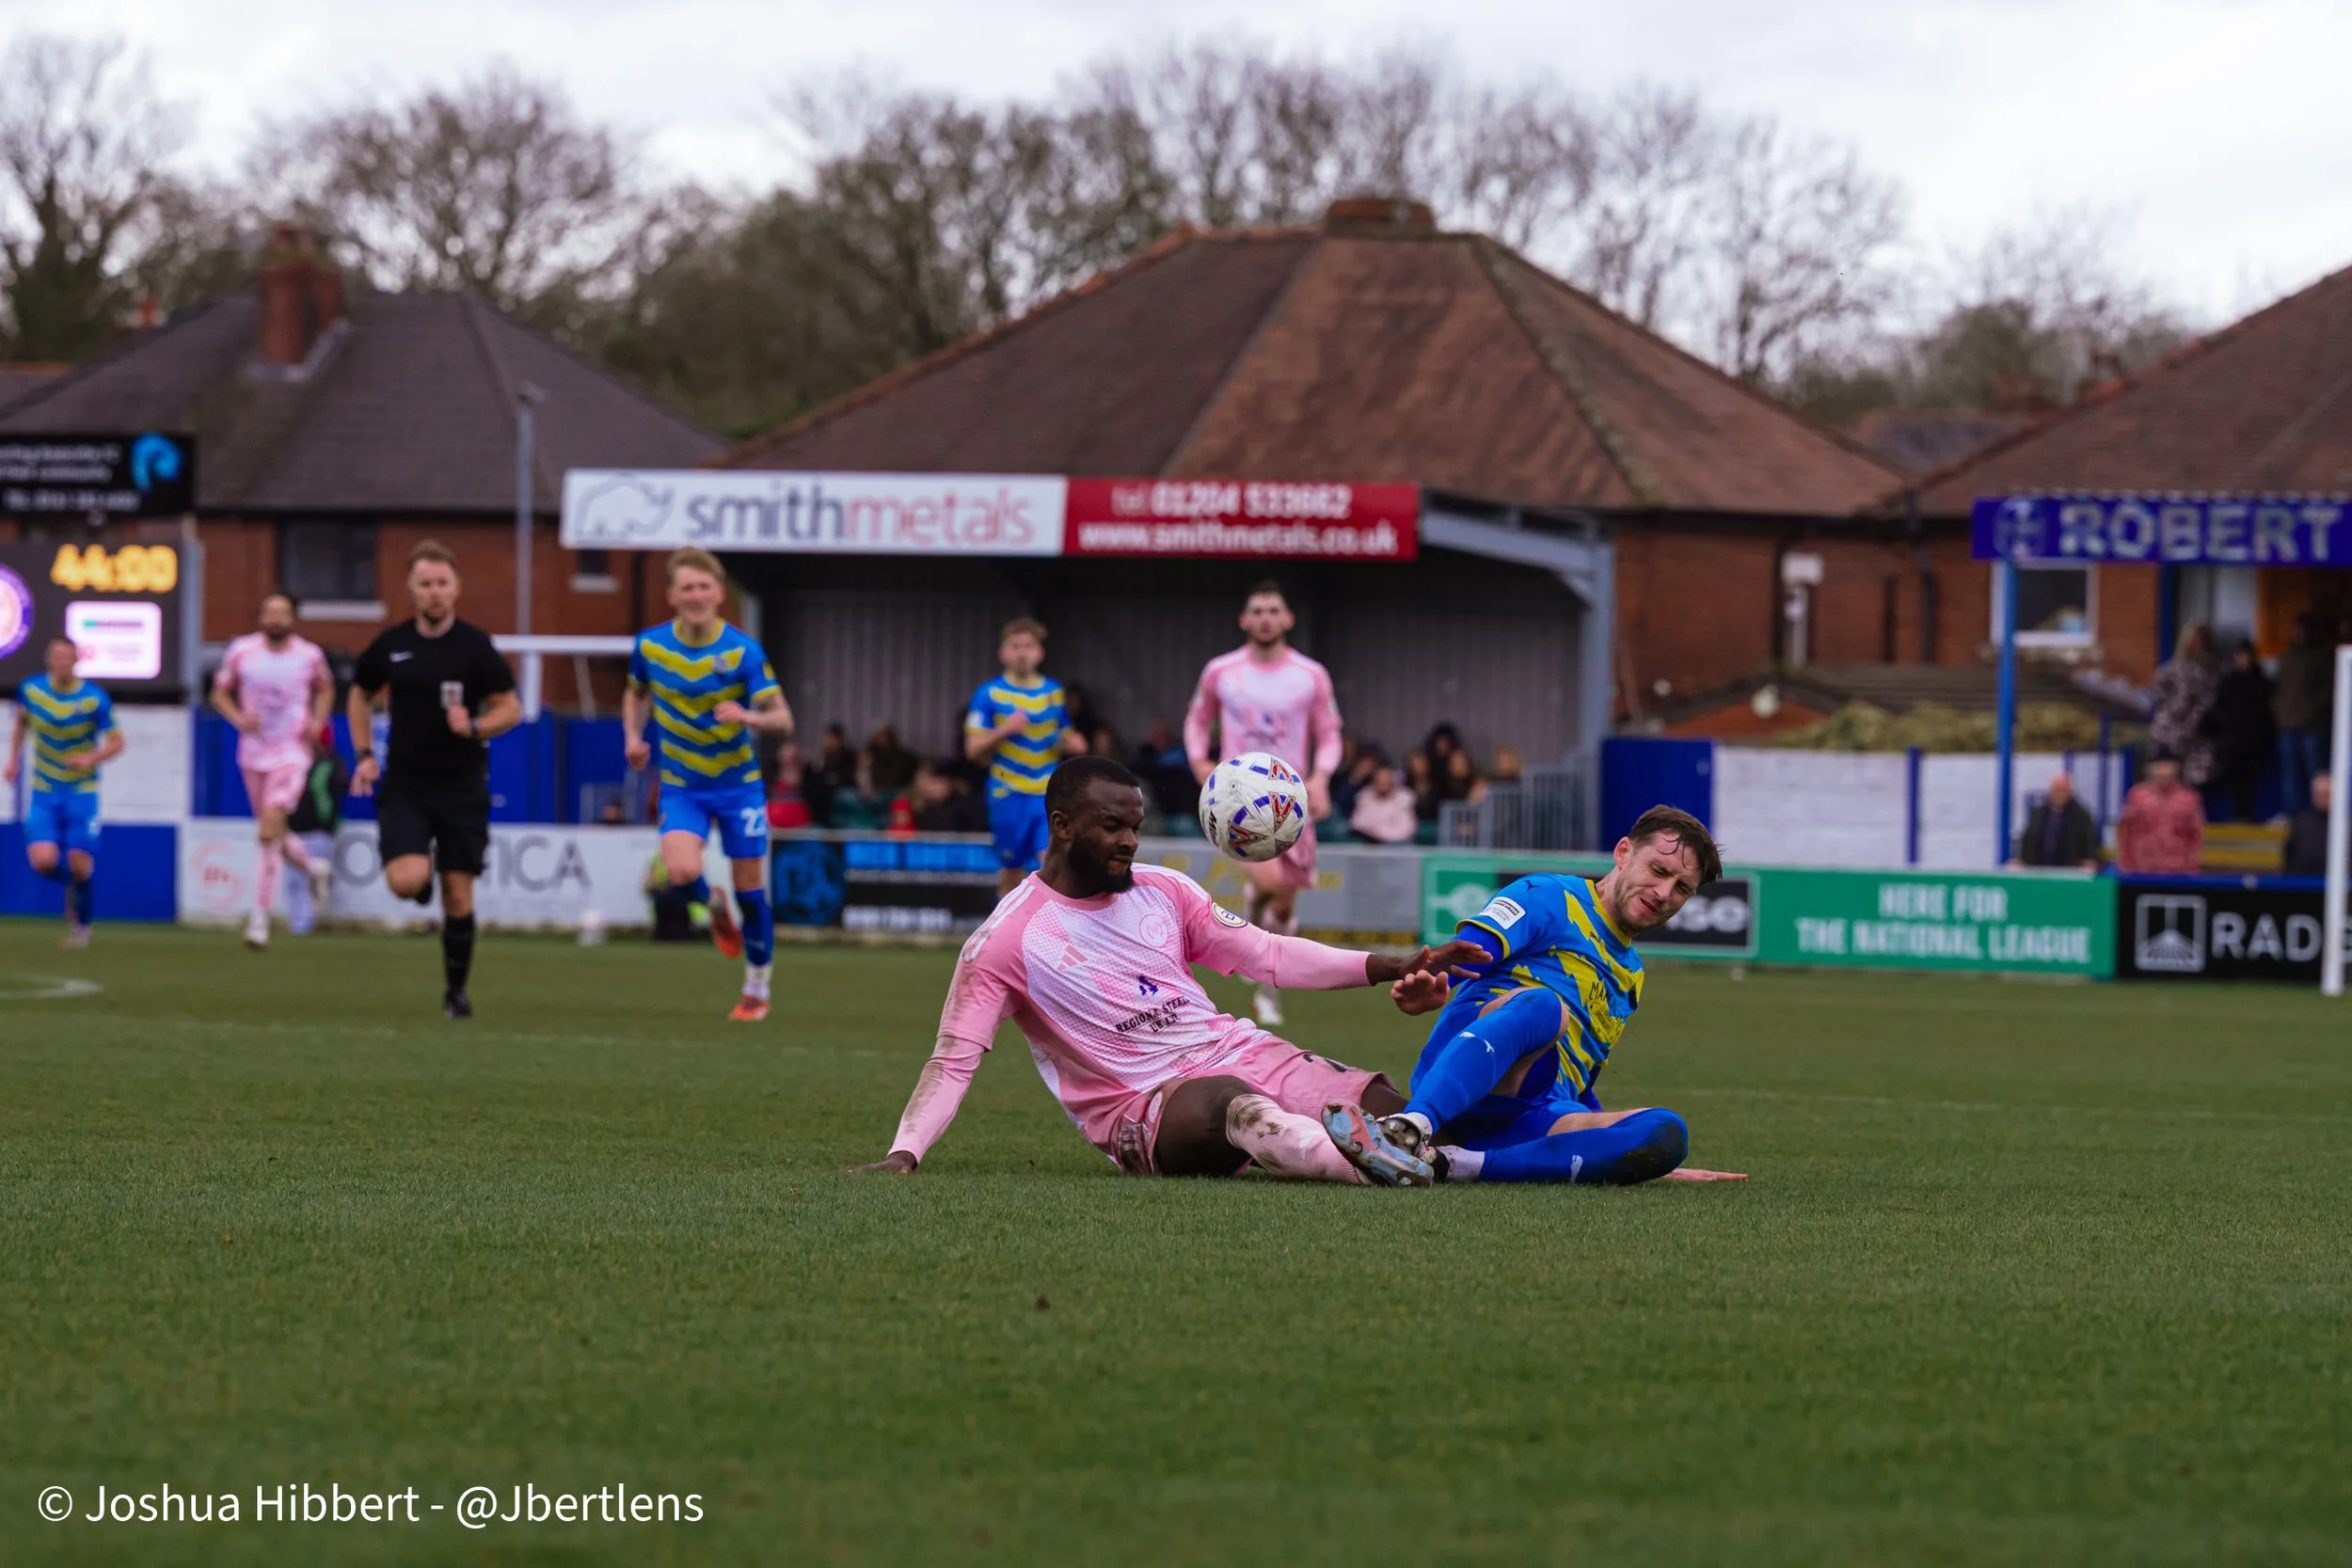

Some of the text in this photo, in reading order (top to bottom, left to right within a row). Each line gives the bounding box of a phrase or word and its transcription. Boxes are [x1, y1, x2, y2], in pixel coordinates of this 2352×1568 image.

[685, 478, 1037, 546] smithmetals
[2059, 503, 2343, 562] ROBERT
[51, 543, 178, 594] 44:00
[1879, 882, 2008, 923] HERE FOR
[1795, 916, 2091, 963] THE NATIONAL LEAGUE
[1149, 1020, 1165, 1033] UK
